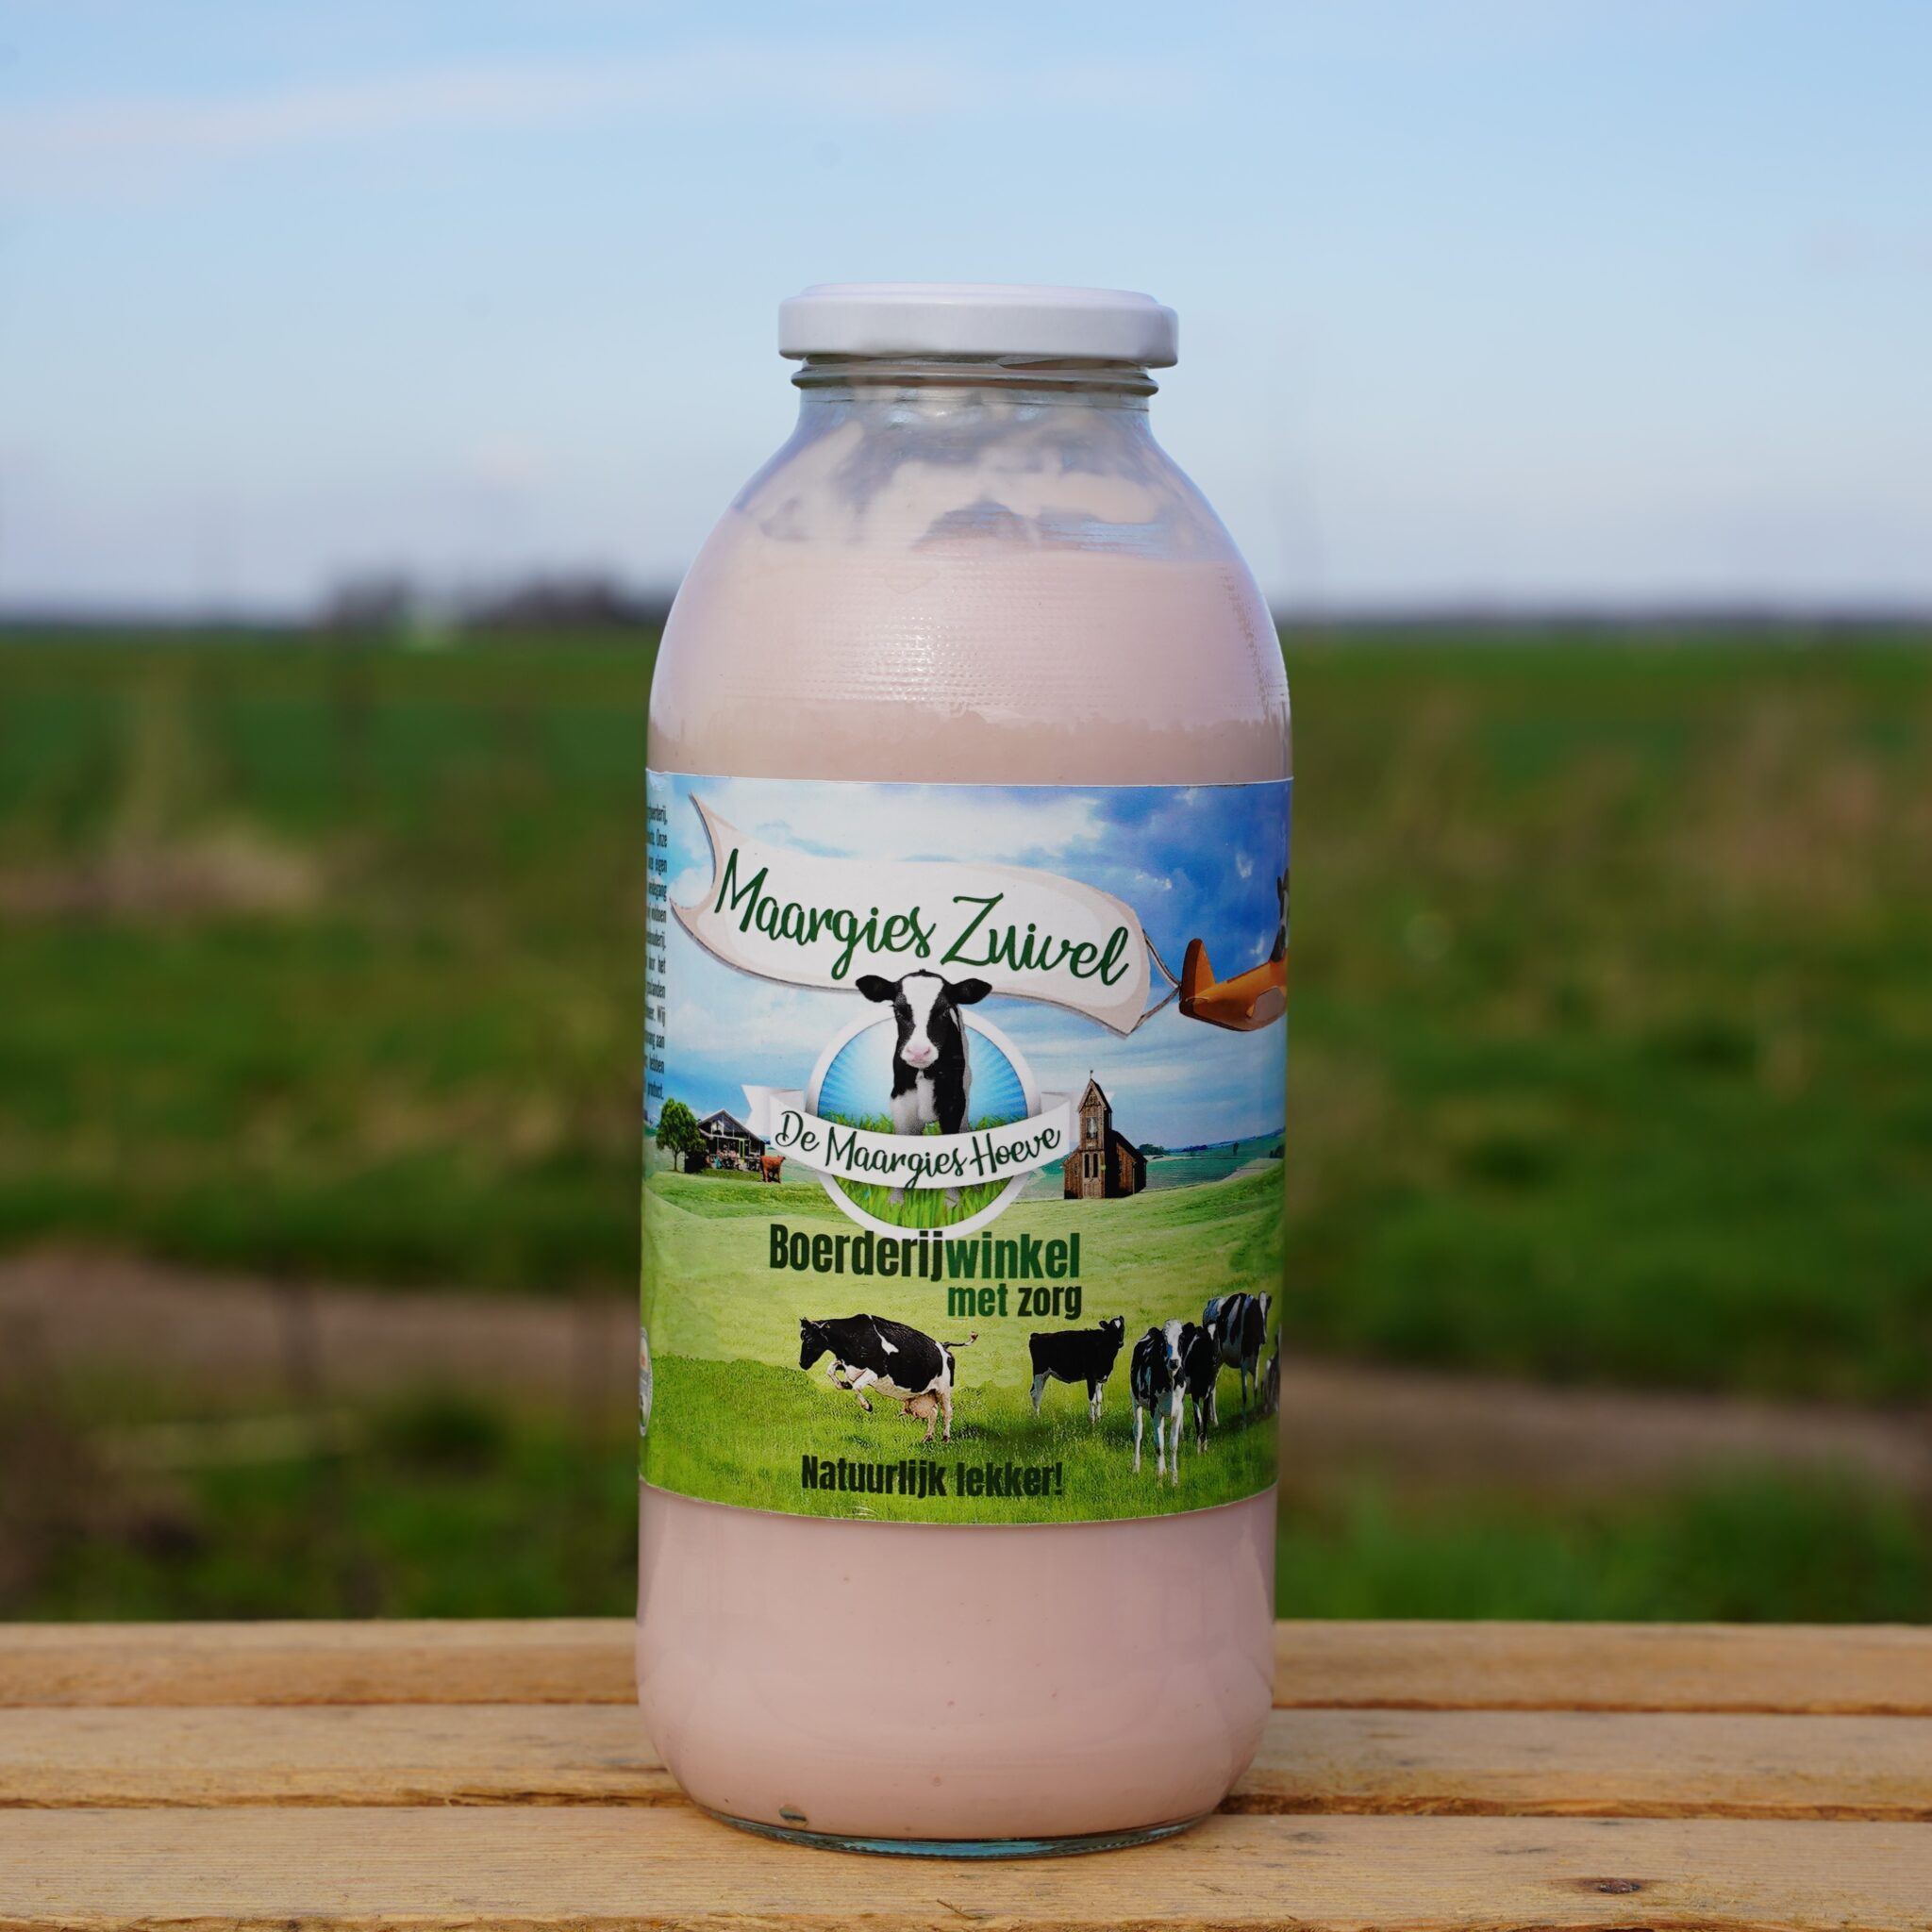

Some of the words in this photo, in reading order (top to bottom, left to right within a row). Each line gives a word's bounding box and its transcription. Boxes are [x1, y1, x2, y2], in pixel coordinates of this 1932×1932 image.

[714, 848, 937, 981] Maargies
[940, 892, 1130, 986] Zuivel
[774, 1110, 820, 1152] De
[824, 1125, 969, 1191] Maargies
[969, 1126, 1062, 1175] Hoeve
[769, 1224, 1081, 1282] Boerderijwinkel
[947, 1284, 1008, 1317] met
[1017, 1285, 1083, 1320] zorg
[802, 1455, 946, 1499] Natuurlijk
[957, 1461, 1064, 1498] lekker!
